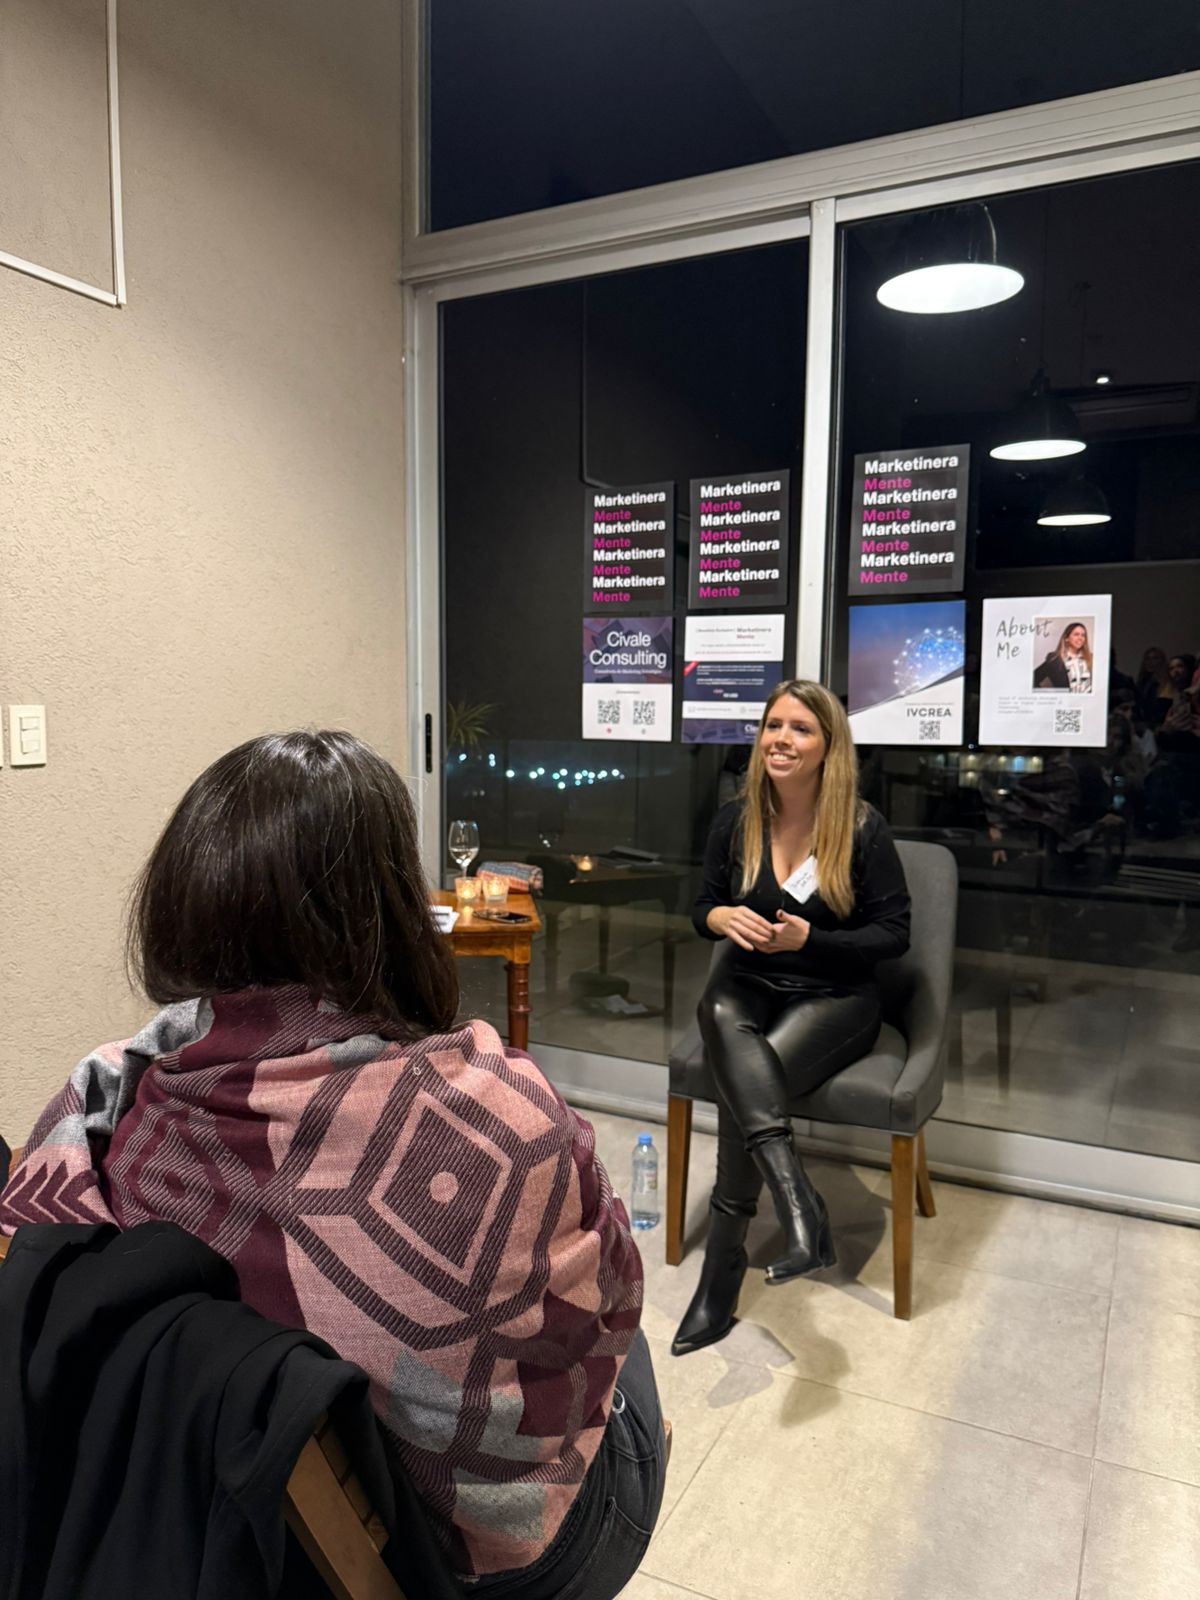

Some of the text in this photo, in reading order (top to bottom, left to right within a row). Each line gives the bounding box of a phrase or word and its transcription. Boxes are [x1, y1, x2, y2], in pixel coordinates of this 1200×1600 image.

[864, 456, 959, 475] Marketinera
[700, 480, 781, 498] Marketinera
[863, 477, 912, 490] Mente
[594, 491, 666, 507] Marketinera
[863, 488, 958, 505] Marketinera
[700, 500, 742, 513] Mente
[593, 510, 631, 521] Mente
[700, 510, 780, 527] Marketinera
[863, 508, 911, 521] Mente
[593, 520, 666, 534] Marketinera
[862, 520, 956, 536] Marketinera
[700, 529, 741, 541] Mente
[593, 538, 631, 549] Mente
[699, 539, 780, 555] Marketinera
[861, 540, 909, 552] Mente
[593, 548, 666, 561] Marketinera
[860, 551, 955, 567] Marketinera
[699, 557, 741, 570] Mente
[592, 565, 631, 576] Mente
[699, 568, 779, 583] Marketinera
[592, 575, 666, 588] Marketinera
[860, 571, 908, 584] Mente
[592, 592, 631, 602] Mente
[698, 586, 740, 598] Mente
[996, 616, 1052, 638] About
[607, 631, 651, 647] Civale
[996, 642, 1020, 659] Me
[589, 649, 667, 669] Consulting
[907, 707, 952, 717] IVCREA
